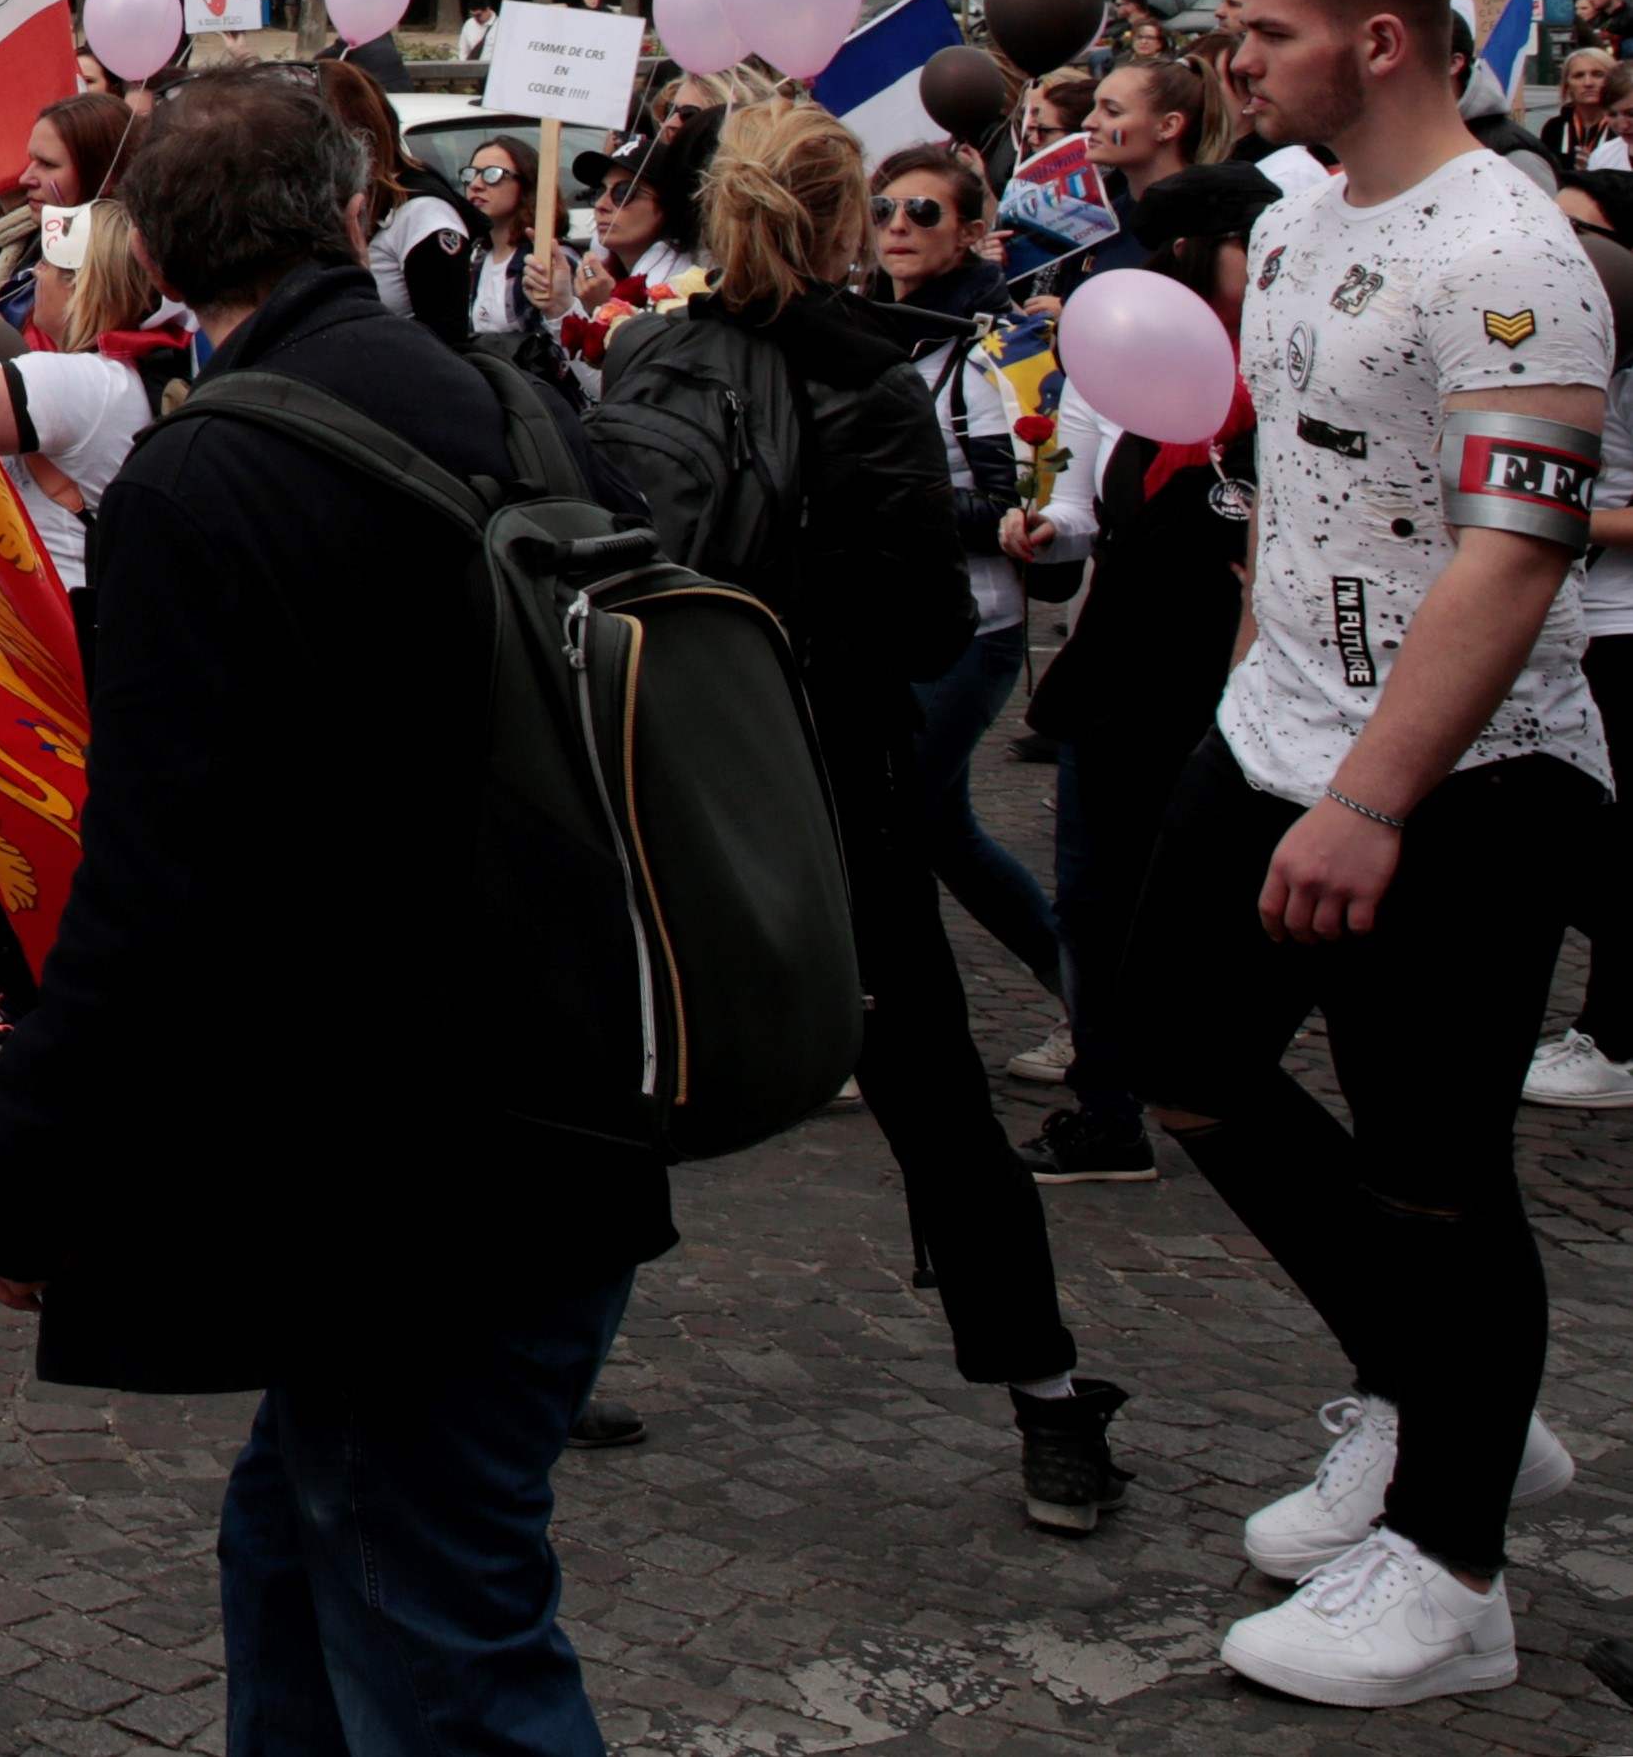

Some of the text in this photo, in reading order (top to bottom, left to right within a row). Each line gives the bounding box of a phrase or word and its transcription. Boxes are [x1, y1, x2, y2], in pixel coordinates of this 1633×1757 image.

[527, 41, 606, 60] FEMME DE CRS
[554, 65, 570, 76] EN
[528, 82, 567, 96] COLERE
[1331, 264, 1384, 318] 23
[1337, 581, 1371, 682] I'M FUTURE
